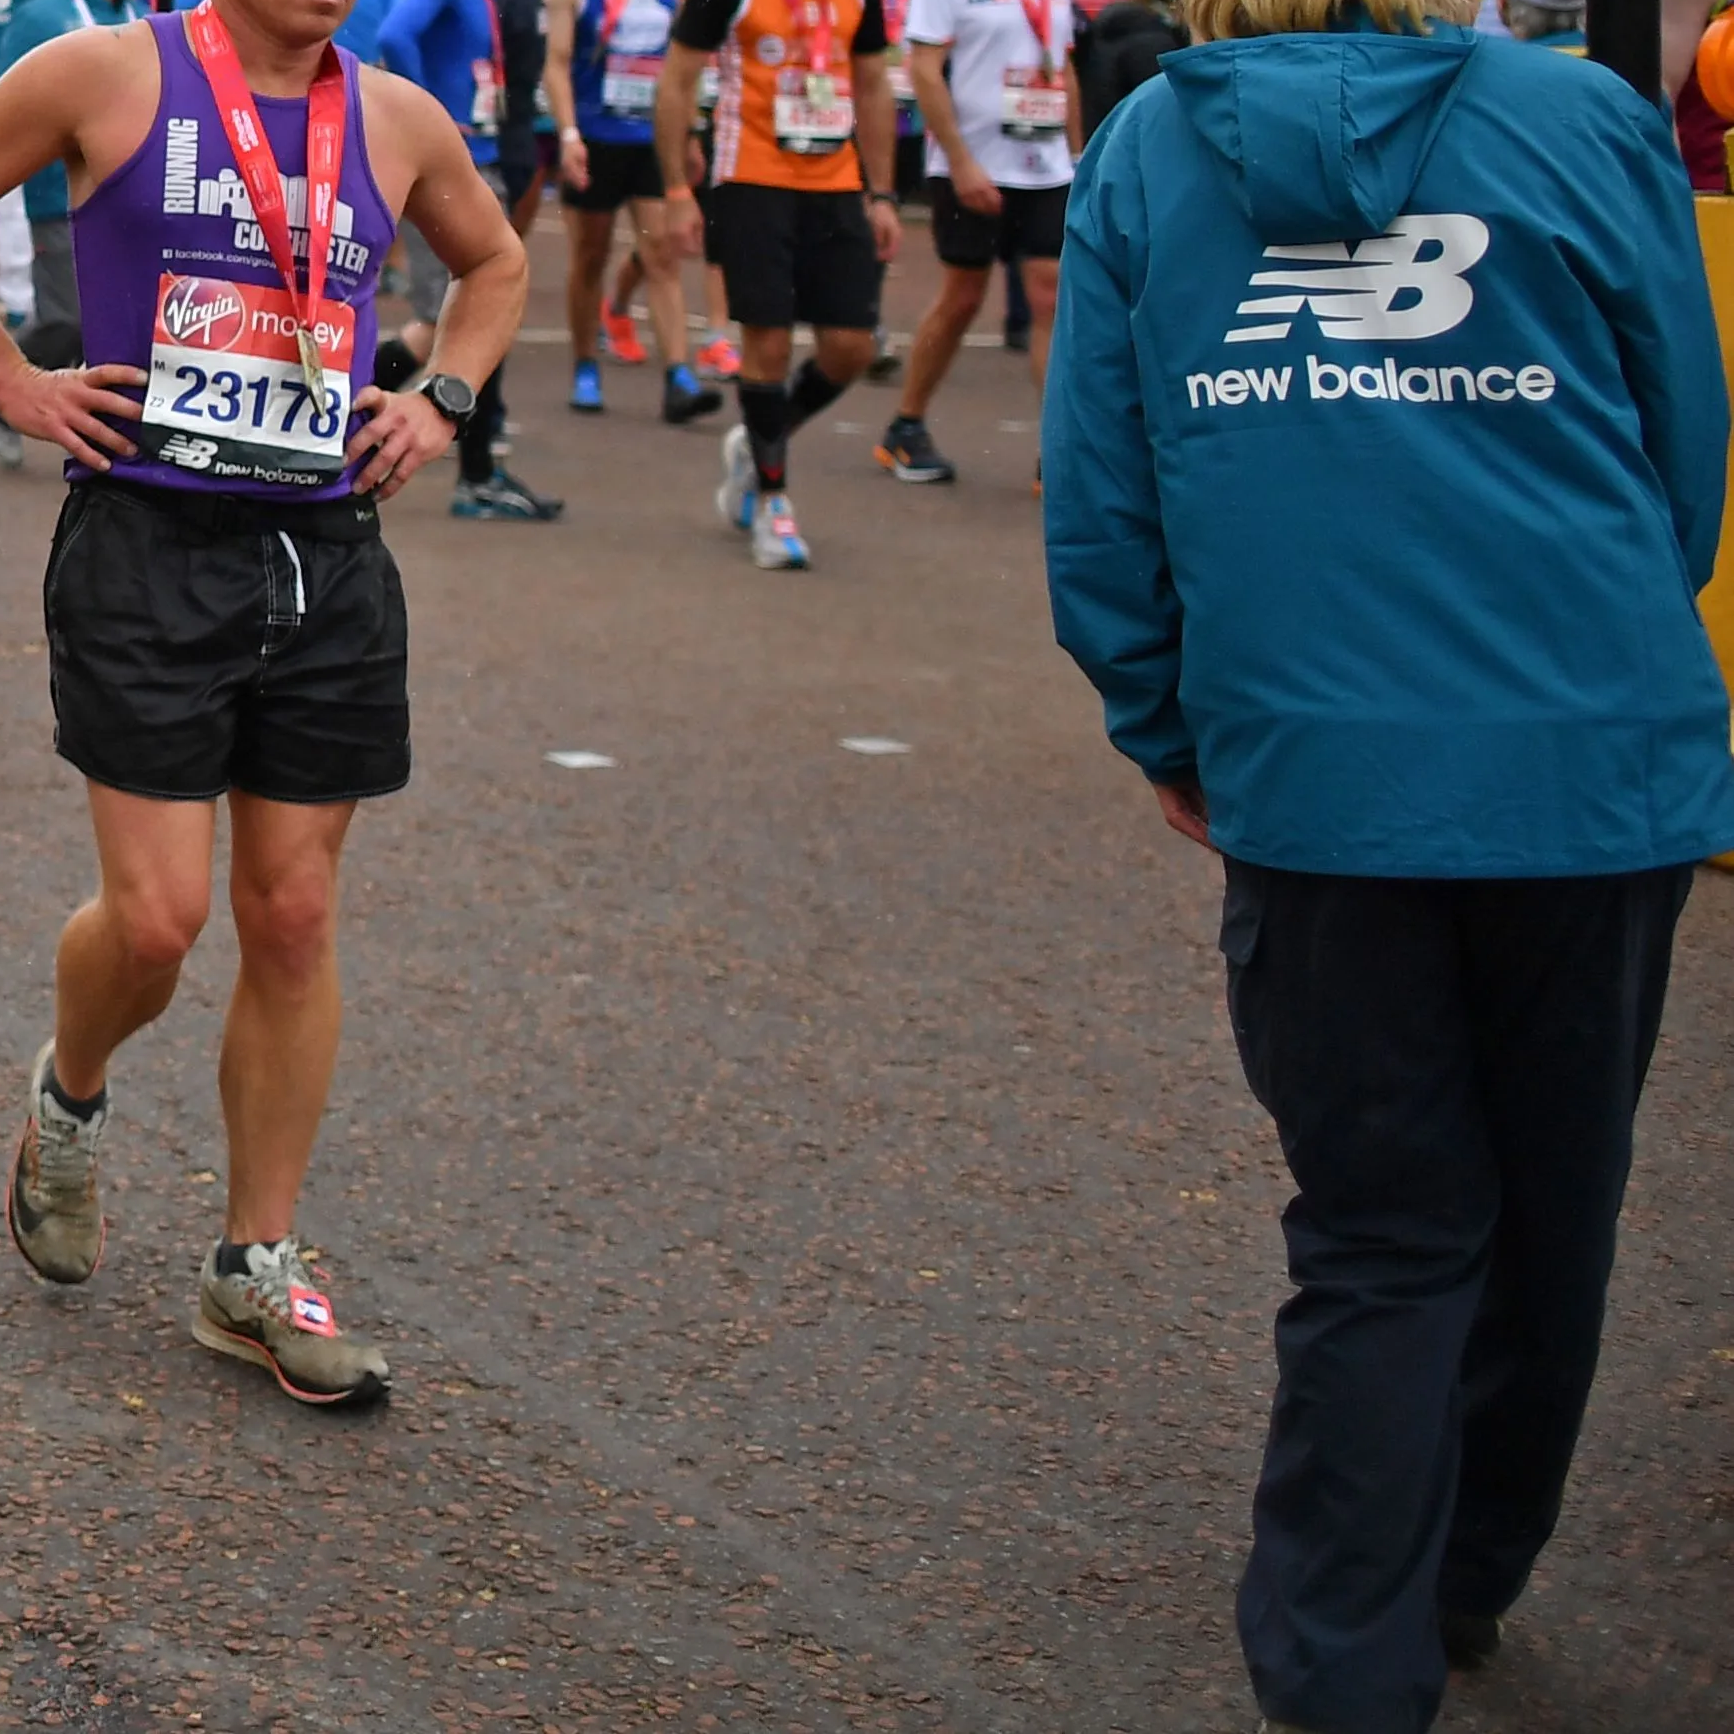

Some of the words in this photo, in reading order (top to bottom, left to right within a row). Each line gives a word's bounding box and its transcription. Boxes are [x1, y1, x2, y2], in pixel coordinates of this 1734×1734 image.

[162, 117, 199, 215] RUNNING
[1223, 213, 1490, 343] NB
[166, 279, 240, 345] Virgin
[251, 309, 345, 351] moey
[171, 365, 341, 439] 23178
[1186, 366, 1292, 409] new
[1306, 355, 1556, 403] balance
[215, 459, 251, 475] new
